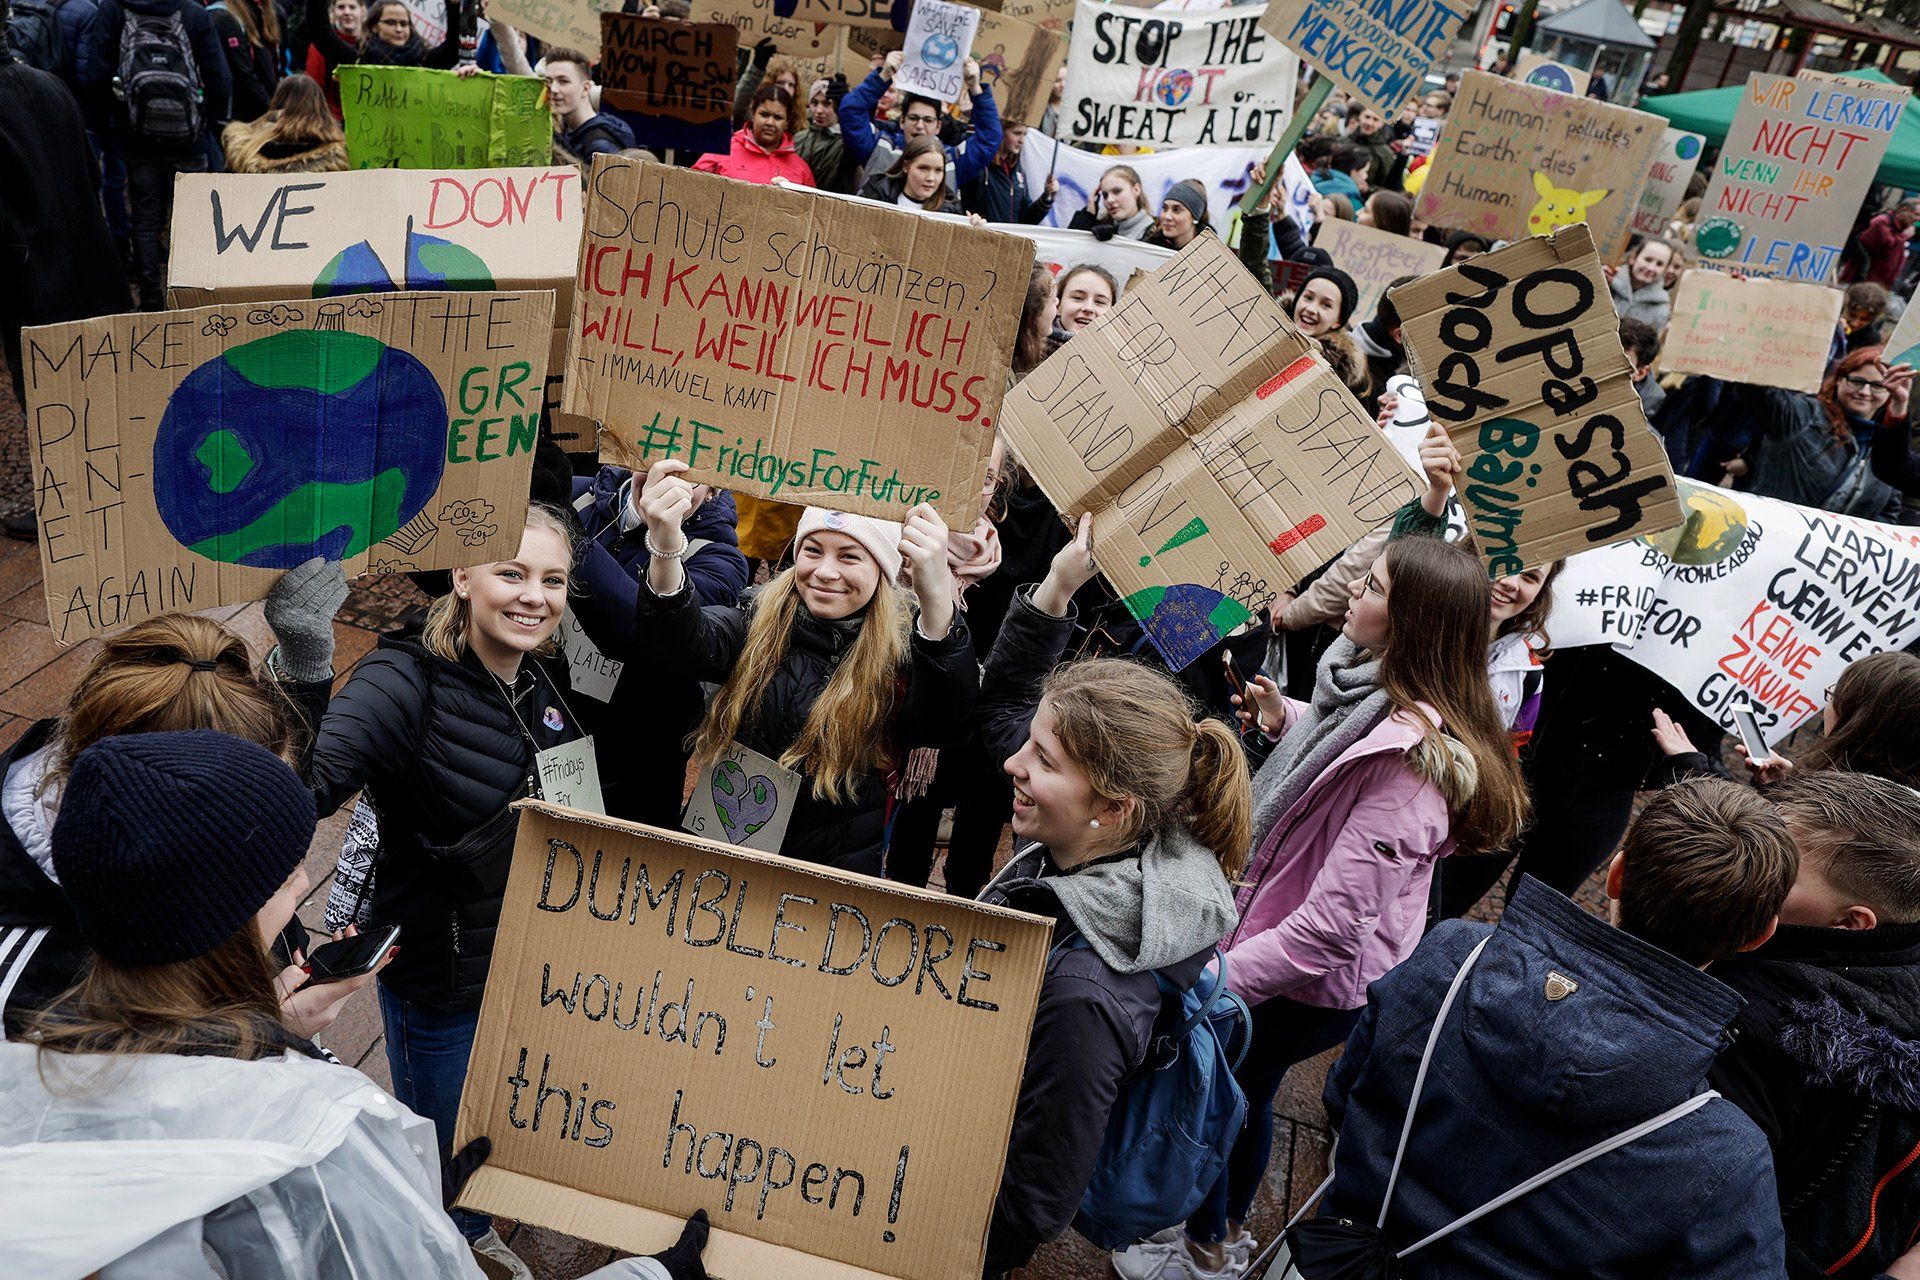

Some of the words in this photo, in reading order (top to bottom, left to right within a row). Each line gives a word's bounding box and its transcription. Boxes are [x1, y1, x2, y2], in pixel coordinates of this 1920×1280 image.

[606, 19, 714, 58] MARCH
[606, 48, 658, 75] NOW
[1093, 12, 1184, 68] STOP
[1203, 16, 1267, 66] THE
[1288, 4, 1418, 120] MENSCHEN!
[1402, 46, 1431, 77] von
[647, 77, 729, 113] LATER
[939, 73, 962, 97] US
[1468, 89, 1552, 132] Human:
[1751, 78, 1797, 112] WIR
[1804, 91, 1902, 133] LERNEN
[1073, 97, 1187, 144] SWEAT
[1196, 109, 1219, 145] A
[1228, 106, 1284, 143] LOT
[1455, 130, 1522, 165] Earth:
[1752, 118, 1870, 172] NICHT
[1441, 171, 1518, 208] Human:
[1717, 185, 1810, 223] NICHT
[1723, 156, 1782, 185] WENN
[1792, 169, 1836, 198] IHR
[210, 182, 327, 255] WE
[423, 171, 577, 230] DON'T
[588, 164, 745, 265] Schule
[1331, 226, 1427, 273] Respect
[383, 297, 522, 353] THE
[583, 243, 653, 300] ICH
[797, 289, 892, 347] WEIL
[904, 309, 972, 366] ICH
[29, 320, 195, 391] MAKE
[581, 302, 685, 368] WILL,
[694, 317, 797, 382] WEIL
[808, 338, 872, 397] ICH
[879, 356, 992, 429] MUSS.
[1425, 263, 1510, 423] noch
[723, 381, 777, 413] KANT
[1097, 296, 1179, 386] FOR
[1156, 371, 1221, 429] IS
[1189, 414, 1304, 512] WHAT
[1158, 235, 1297, 367] WHAT
[1275, 387, 1417, 523] STAND
[1495, 267, 1600, 418] Opa
[1553, 413, 1668, 544] sah
[448, 412, 540, 465] EEN
[1027, 354, 1135, 473] STAND
[638, 410, 942, 507] #FridaysForFuture
[453, 507, 480, 519] CO2
[1466, 416, 1543, 580] Bäume
[61, 562, 197, 642] AGAIN
[1642, 597, 1702, 649] FOR
[1766, 567, 1857, 646] WENN
[573, 645, 621, 679] LATER
[1739, 598, 1822, 681] KEINE
[1717, 633, 1819, 730] ZUKUNFT
[541, 756, 585, 786] #Fridays
[691, 809, 706, 832] is
[536, 836, 1008, 1013] DUMBLEDORE
[540, 961, 777, 1070] wouldn't
[822, 1010, 897, 1101] let
[506, 1045, 617, 1149] this
